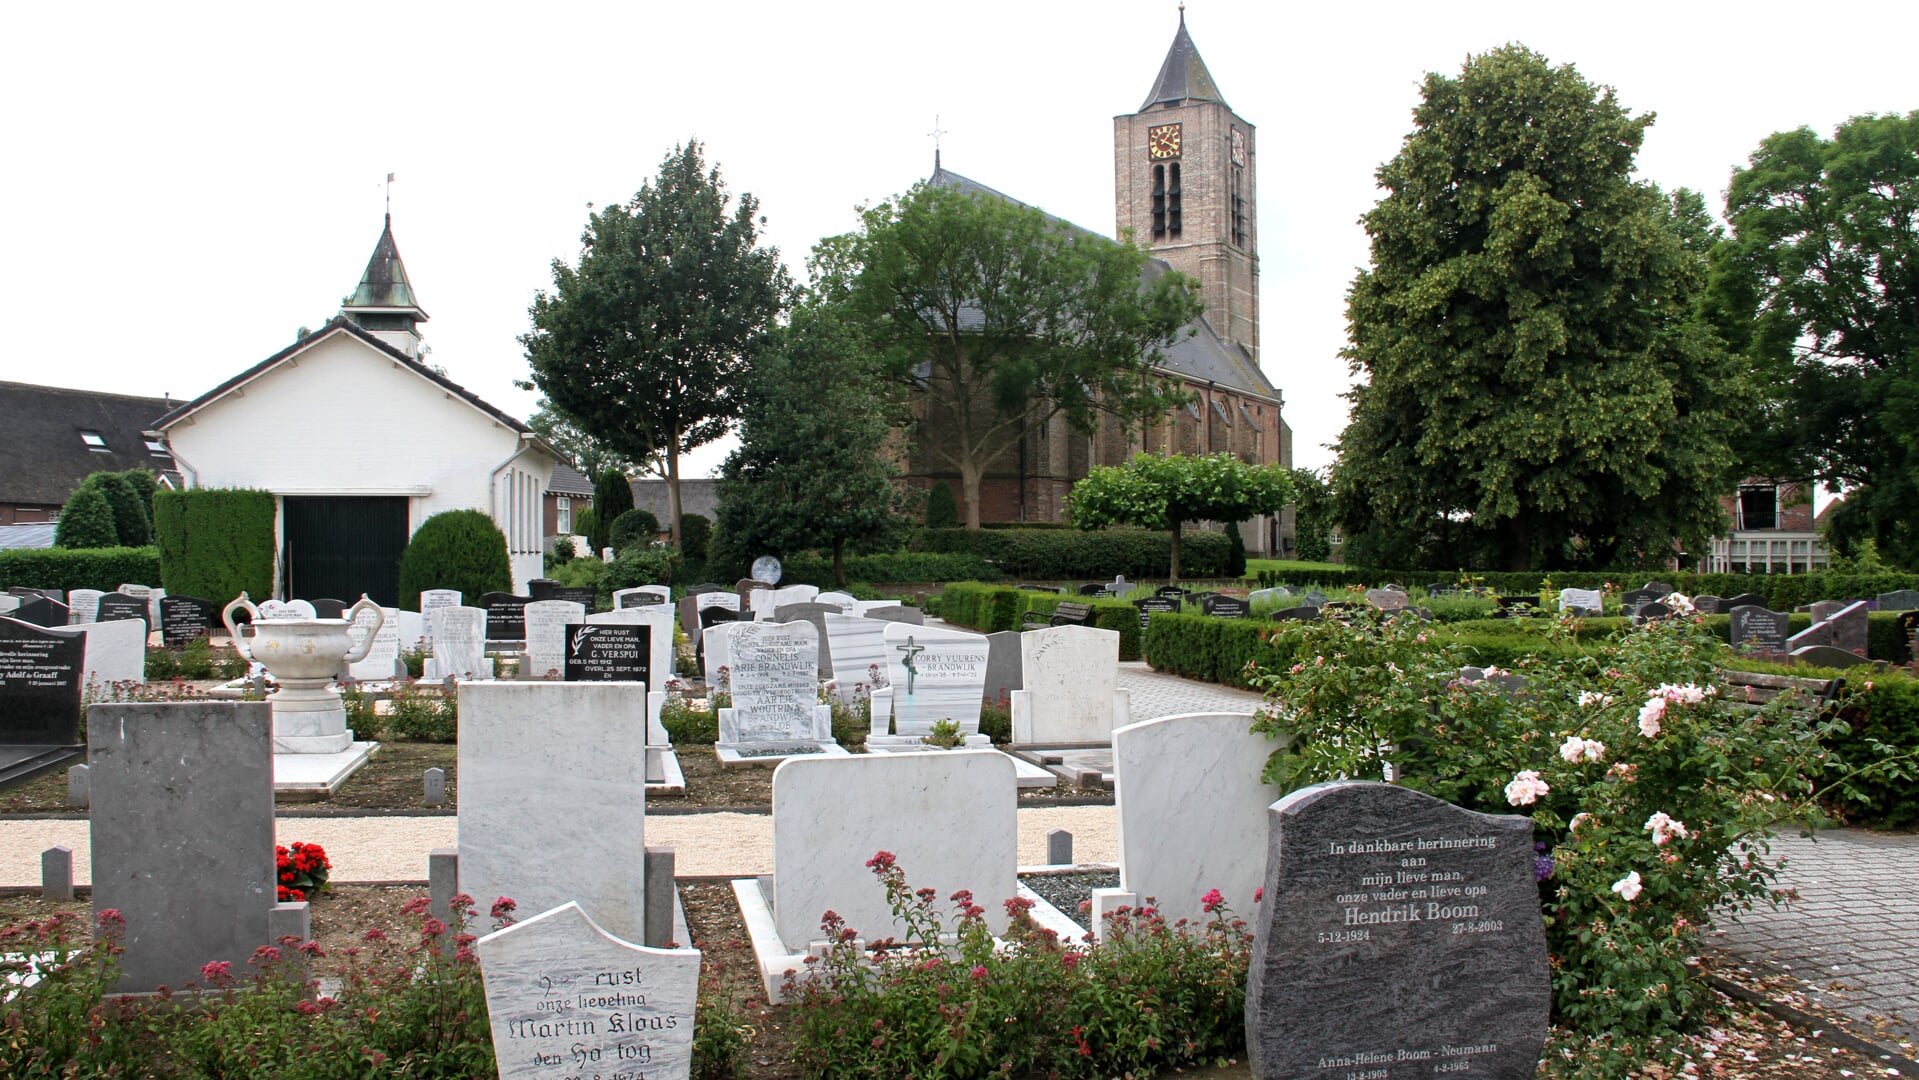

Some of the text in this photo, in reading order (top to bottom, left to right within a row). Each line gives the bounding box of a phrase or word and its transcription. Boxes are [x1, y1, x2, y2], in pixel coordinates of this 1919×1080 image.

[591, 650, 639, 659] G. VERSPUI
[755, 653, 799, 662] CORNELIS
[915, 654, 985, 662] CORRY VUURENS
[734, 661, 815, 672] ARIE BRANDWIJK
[927, 663, 976, 671] BRANDWIJK
[5, 671, 27, 679] Adolf
[33, 671, 58, 679] Graaff
[757, 695, 794, 704] AARTJE
[750, 704, 801, 713] WOUTRINA
[1329, 835, 1497, 855] In dankbare herinnering
[1401, 857, 1427, 867] aan
[1361, 871, 1465, 887] mijn lieve man,
[1336, 885, 1488, 903] onze vader en lieve opa
[1344, 902, 1479, 926] Hendrik Boom
[1452, 919, 1504, 934] 27-8-2003
[1318, 929, 1370, 944] 5-12-1924
[595, 967, 642, 987] rust
[536, 998, 571, 1016] onze
[509, 1012, 678, 1039] Martin Klaas
[534, 1042, 652, 1069] den Hatog
[1317, 1051, 1394, 1069] Anna-Helene
[1397, 1048, 1431, 1062] Boom
[1441, 1042, 1497, 1058] Neumann
